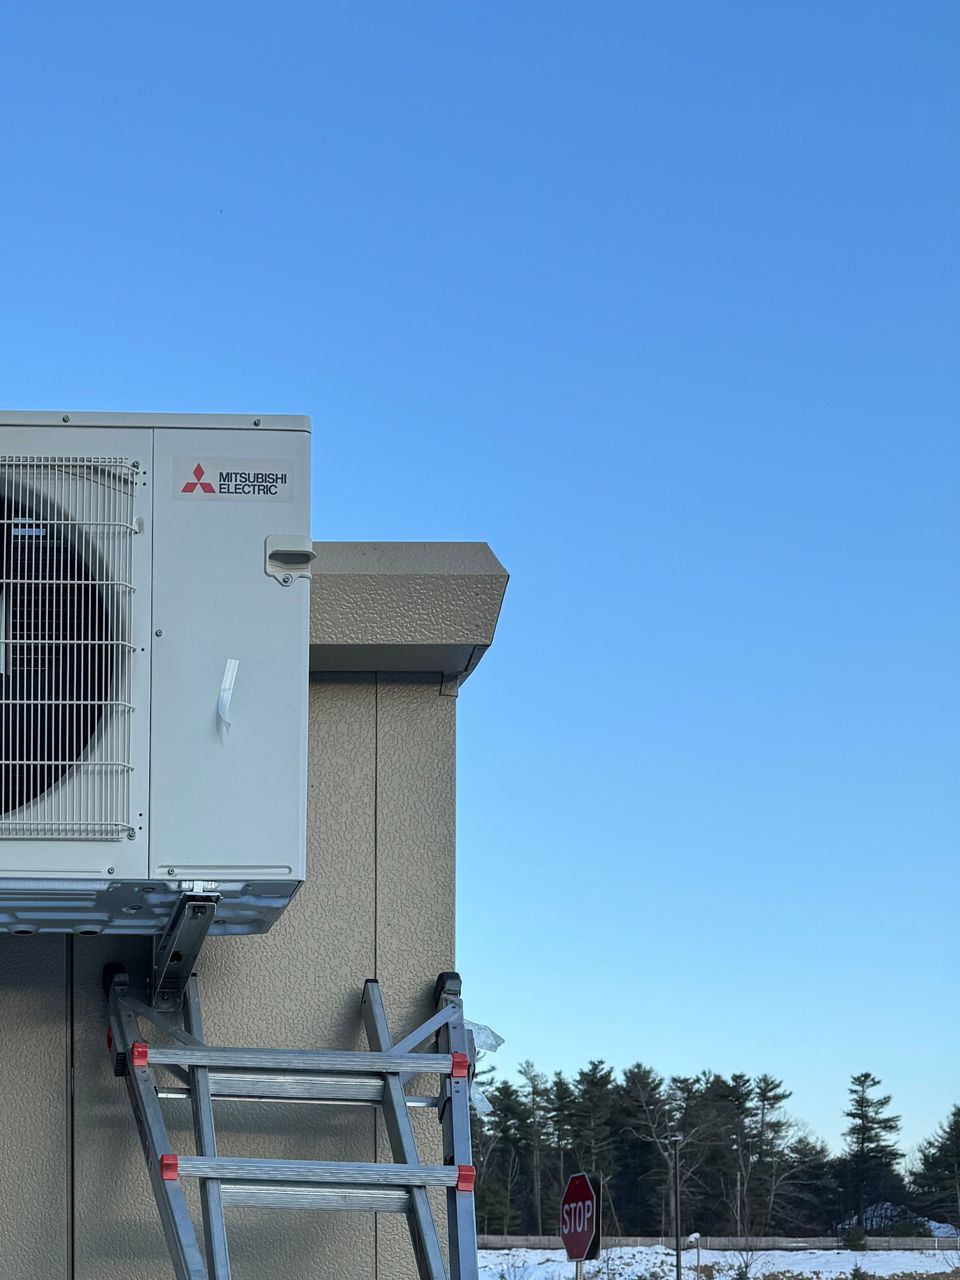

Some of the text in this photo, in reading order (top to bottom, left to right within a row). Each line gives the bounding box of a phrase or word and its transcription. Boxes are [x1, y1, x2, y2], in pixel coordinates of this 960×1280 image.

[218, 472, 287, 484] MITSUBISHI
[218, 484, 278, 495] ELECTRIC
[562, 1200, 592, 1234] STOP
